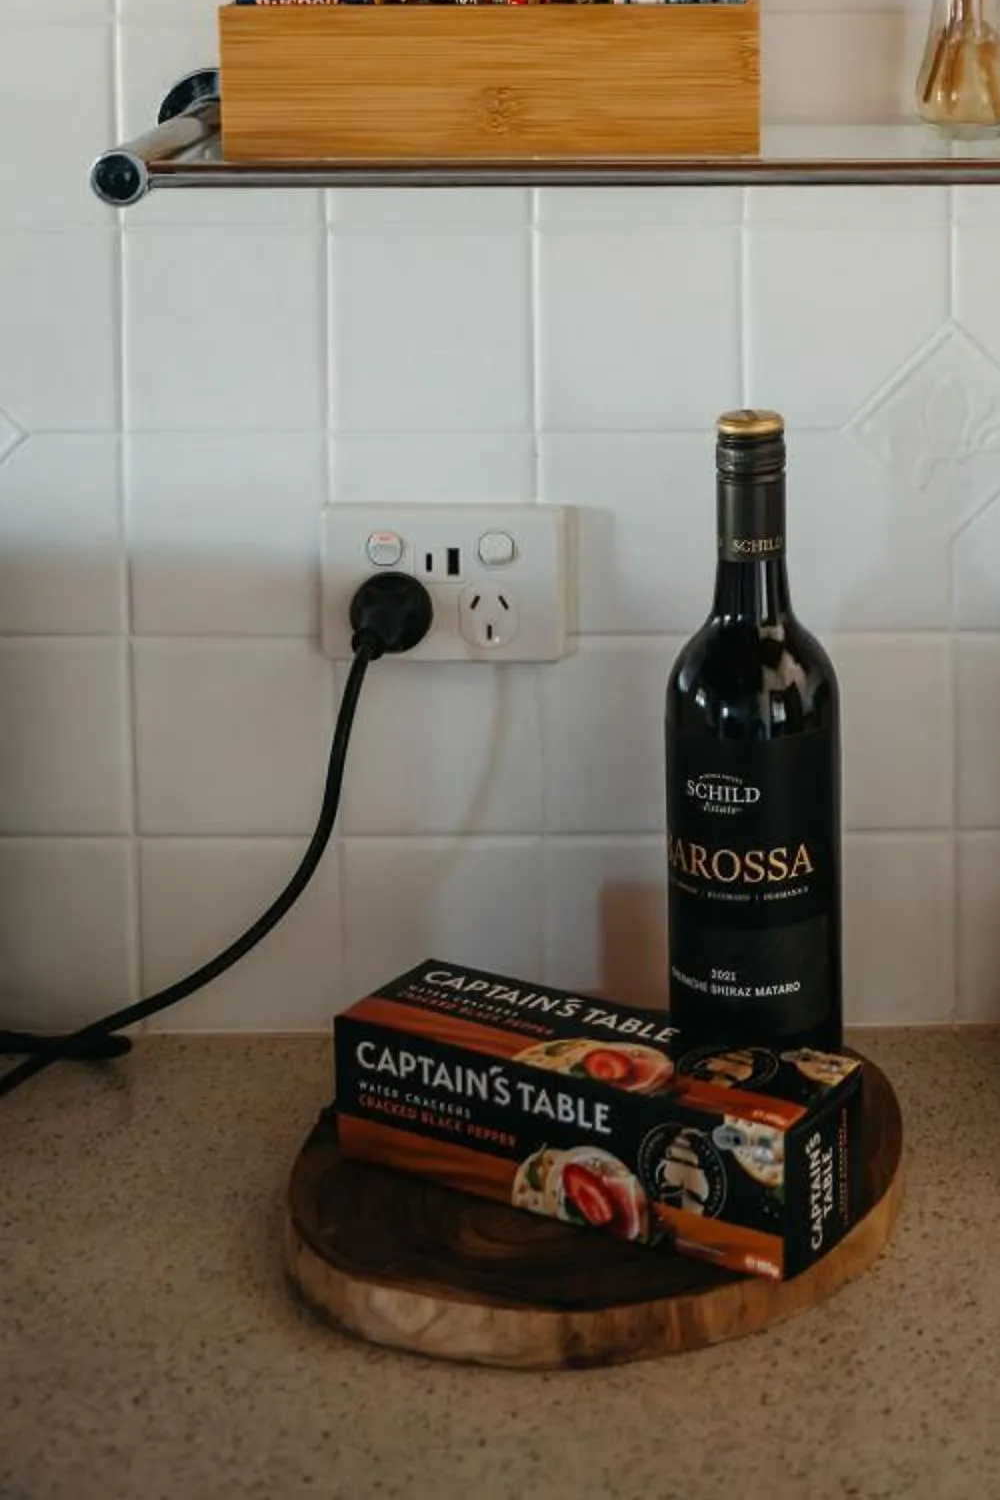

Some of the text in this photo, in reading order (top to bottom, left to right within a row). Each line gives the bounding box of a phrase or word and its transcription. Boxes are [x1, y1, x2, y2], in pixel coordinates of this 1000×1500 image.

[687, 779, 761, 803] SCHILD
[425, 970, 680, 1043] CAPTAIN'S TABLE
[710, 984, 751, 997] SHIRAZ
[755, 980, 801, 997] MATARO
[356, 1040, 612, 1134] CAPTAIN'S TABLE
[421, 1111, 461, 1133] BLACK
[467, 1122, 517, 1147] PEPPER
[808, 1131, 822, 1250] CAPTAIN'S
[822, 1146, 833, 1218] TABLE
